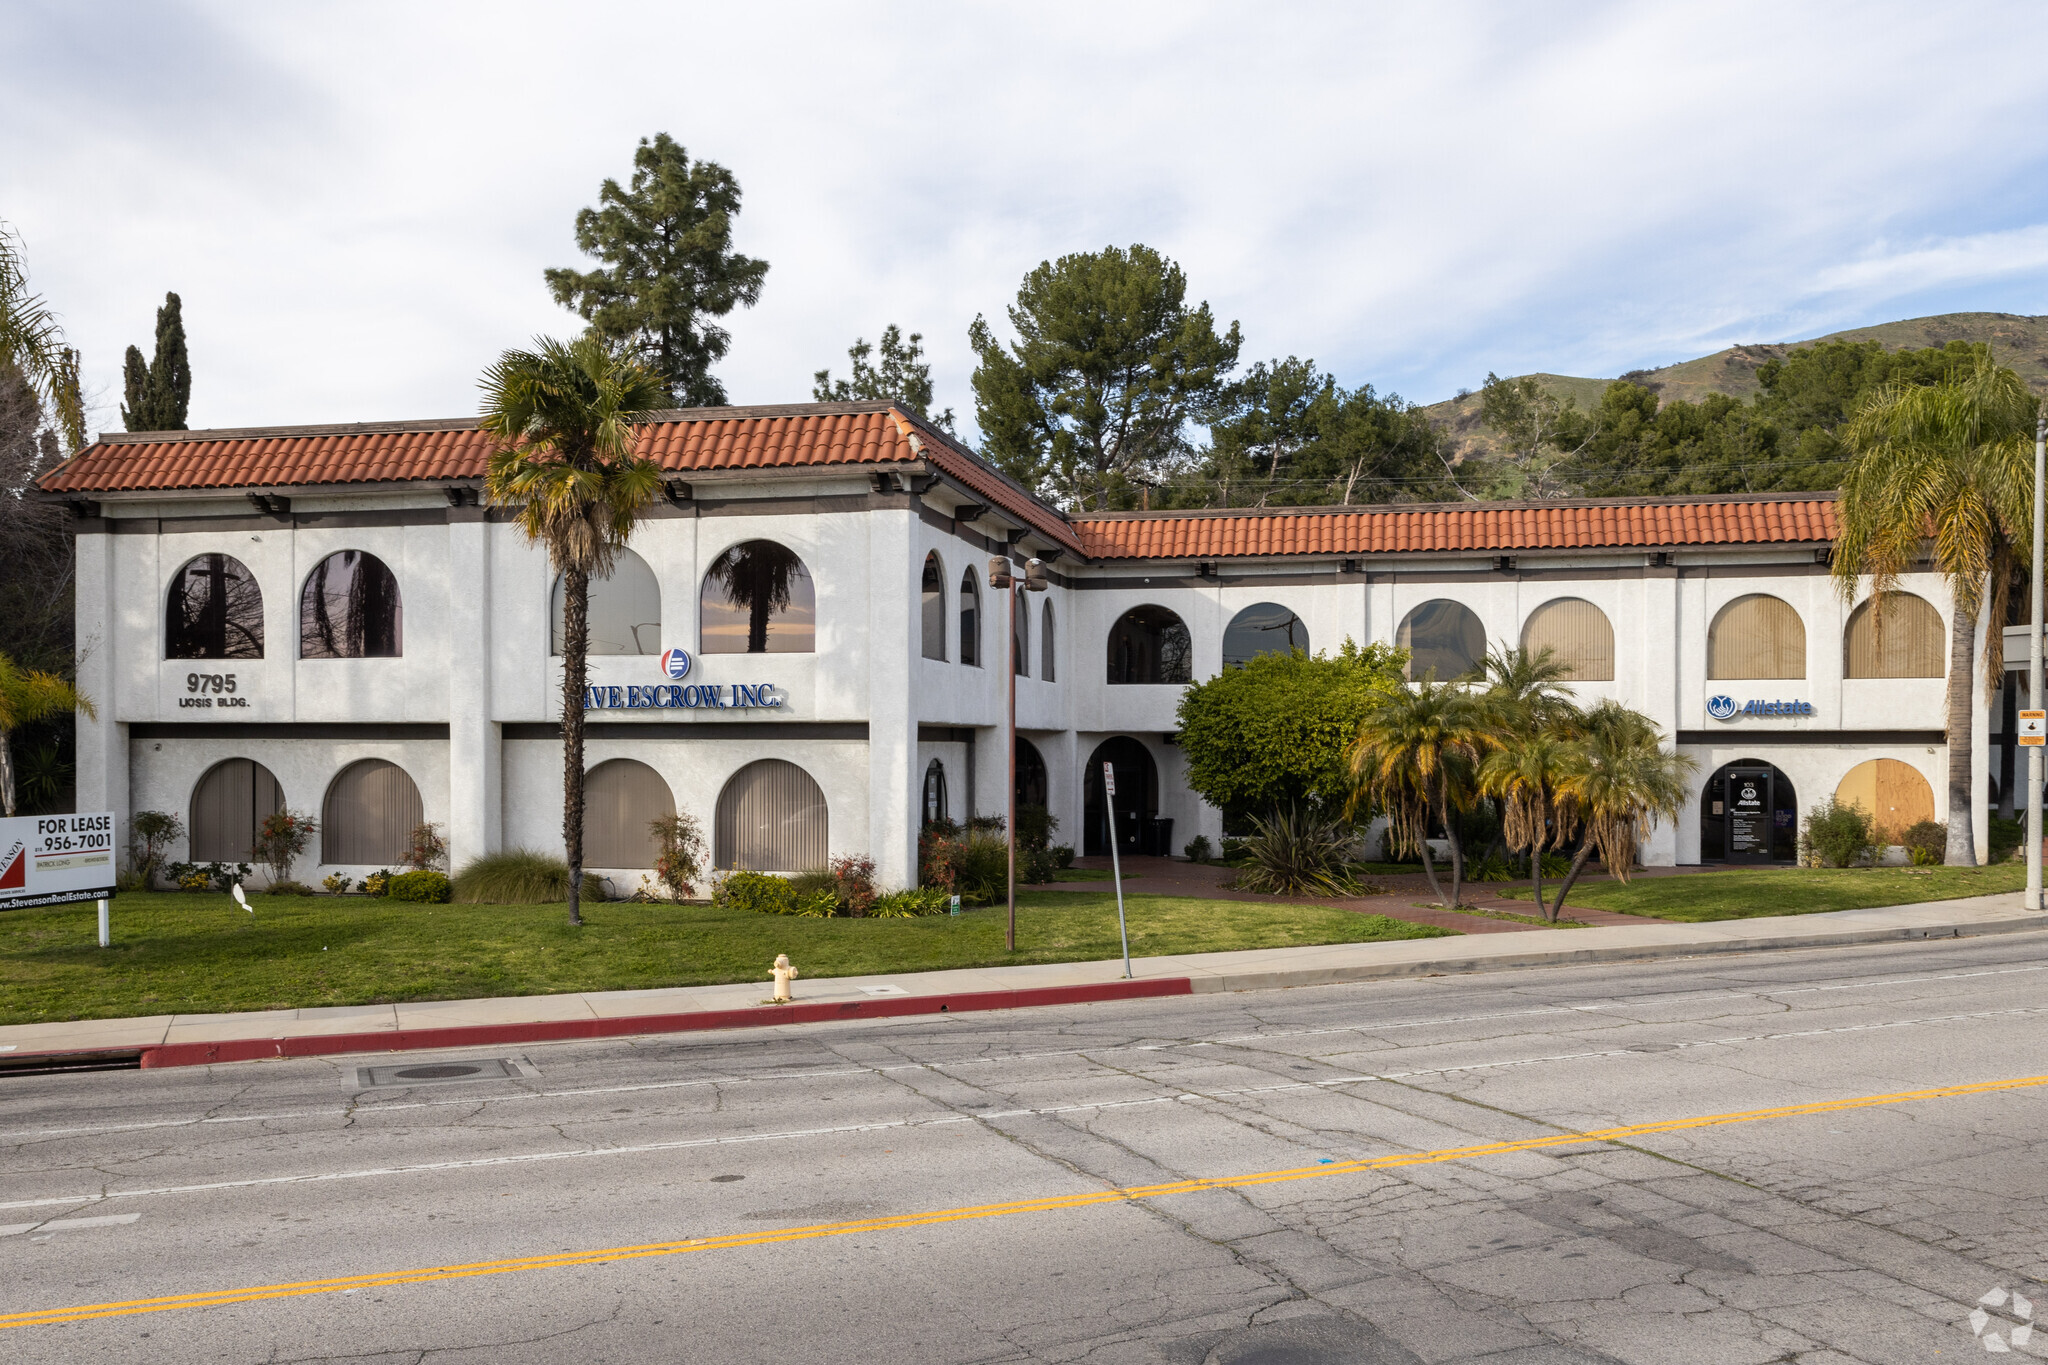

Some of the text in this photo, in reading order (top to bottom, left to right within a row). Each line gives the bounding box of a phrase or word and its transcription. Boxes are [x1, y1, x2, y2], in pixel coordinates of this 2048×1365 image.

[187, 673, 236, 693] 9795
[217, 697, 251, 708] BLDG.
[627, 684, 725, 710] ESCROW,
[731, 683, 781, 707] INC.
[1741, 698, 1812, 715] Allstate
[38, 816, 111, 835] FOR LEASE
[44, 833, 111, 851] 956-7001
